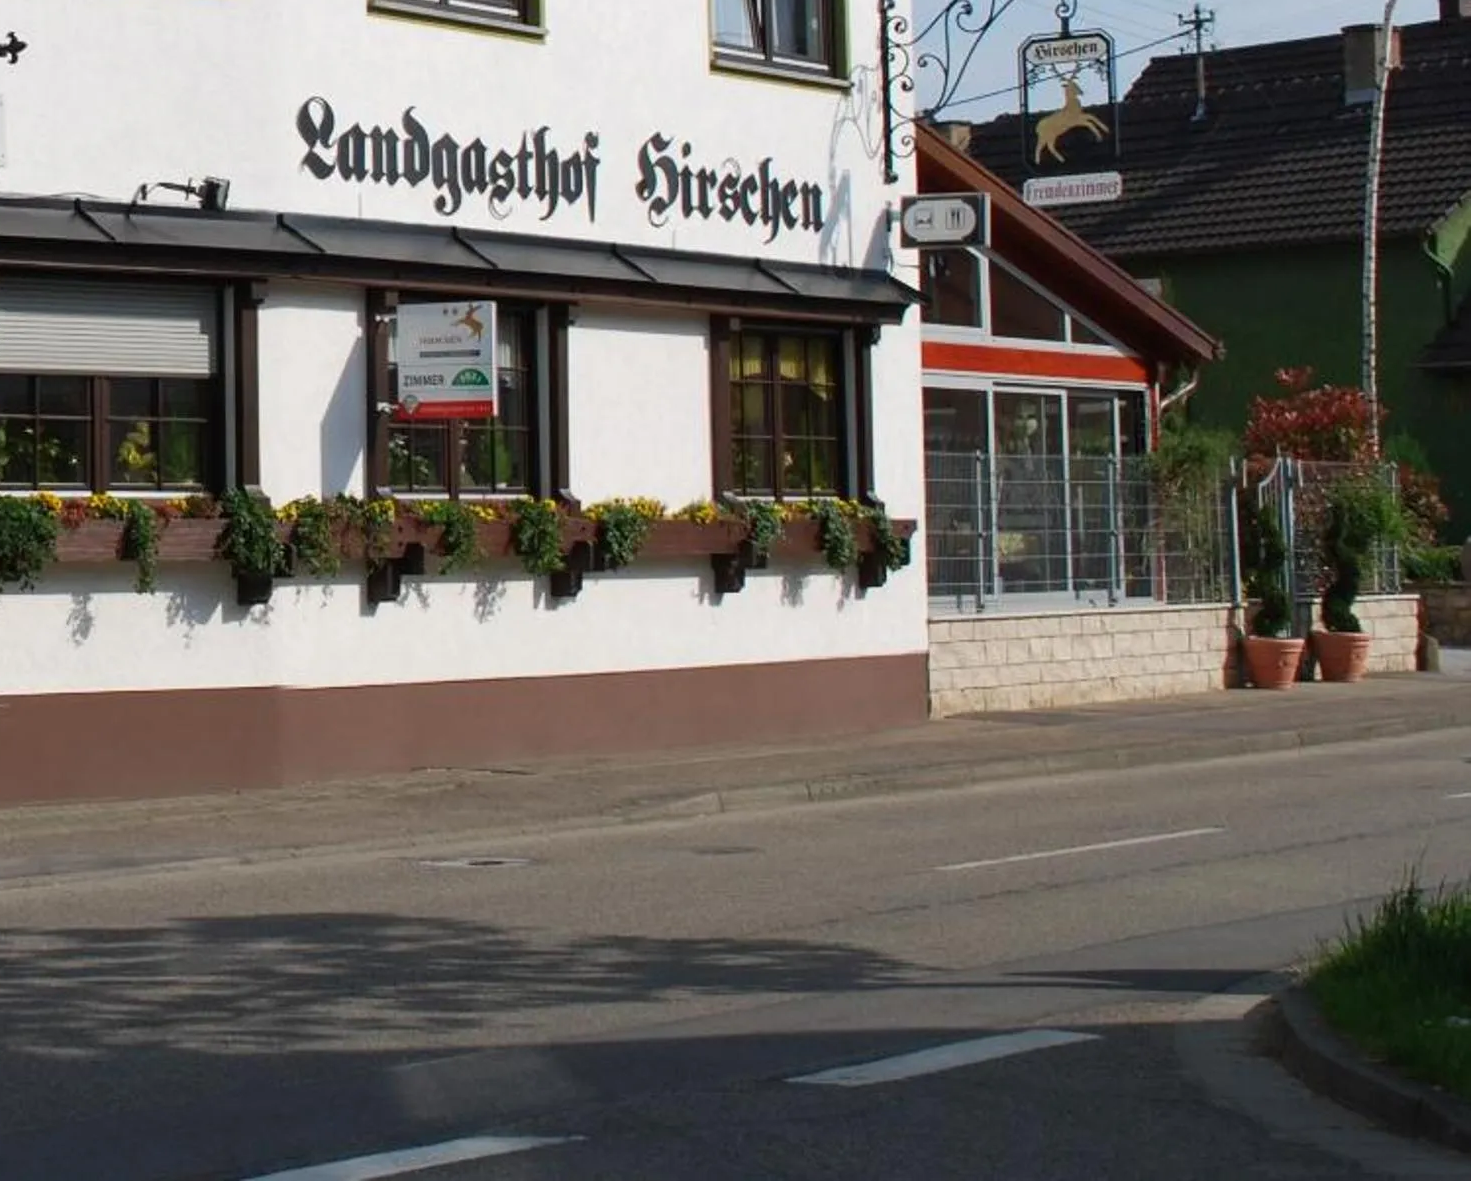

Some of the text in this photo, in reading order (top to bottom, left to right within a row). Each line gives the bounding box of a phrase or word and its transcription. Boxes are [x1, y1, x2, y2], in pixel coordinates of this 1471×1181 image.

[1034, 42, 1098, 60] Hirschen
[296, 96, 825, 245] Landgasthof Hirschen
[403, 373, 445, 388] ZIMMER
